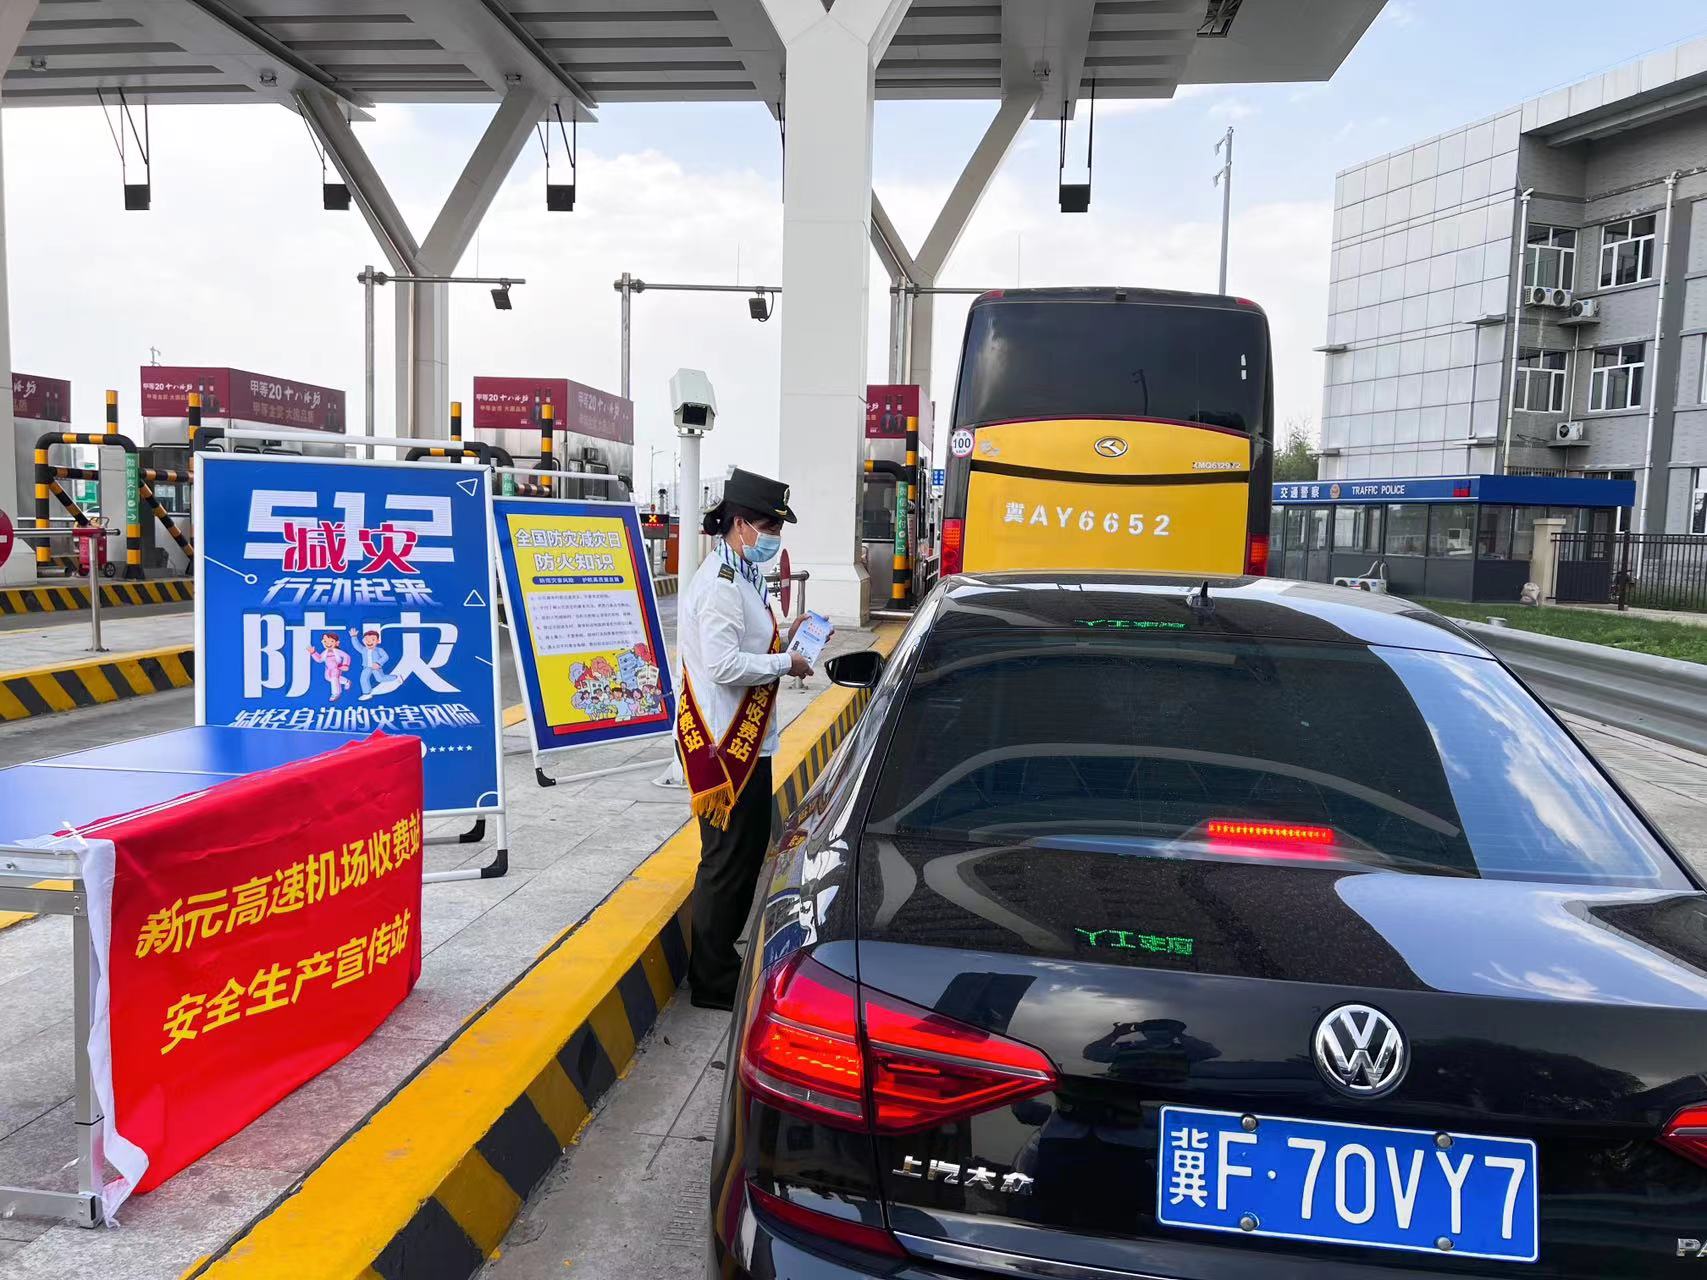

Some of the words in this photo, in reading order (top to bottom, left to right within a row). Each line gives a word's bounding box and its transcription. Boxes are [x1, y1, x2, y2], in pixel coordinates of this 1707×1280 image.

[953, 437, 971, 448] 100
[1280, 486, 1320, 499] 交通警察
[1352, 486, 1378, 495] TRAFFIC
[1381, 485, 1405, 495] POLICE
[282, 521, 421, 574] 减灾
[515, 528, 622, 548] 全国防灾减灾日
[533, 553, 615, 571] 防火知识
[263, 577, 437, 605] 行动起来
[243, 611, 462, 699] 防灾
[135, 808, 420, 959] 新元高速机场收费站
[161, 908, 411, 1056] 安全生产宣传站
[892, 1155, 1035, 1196] 上汽大众
